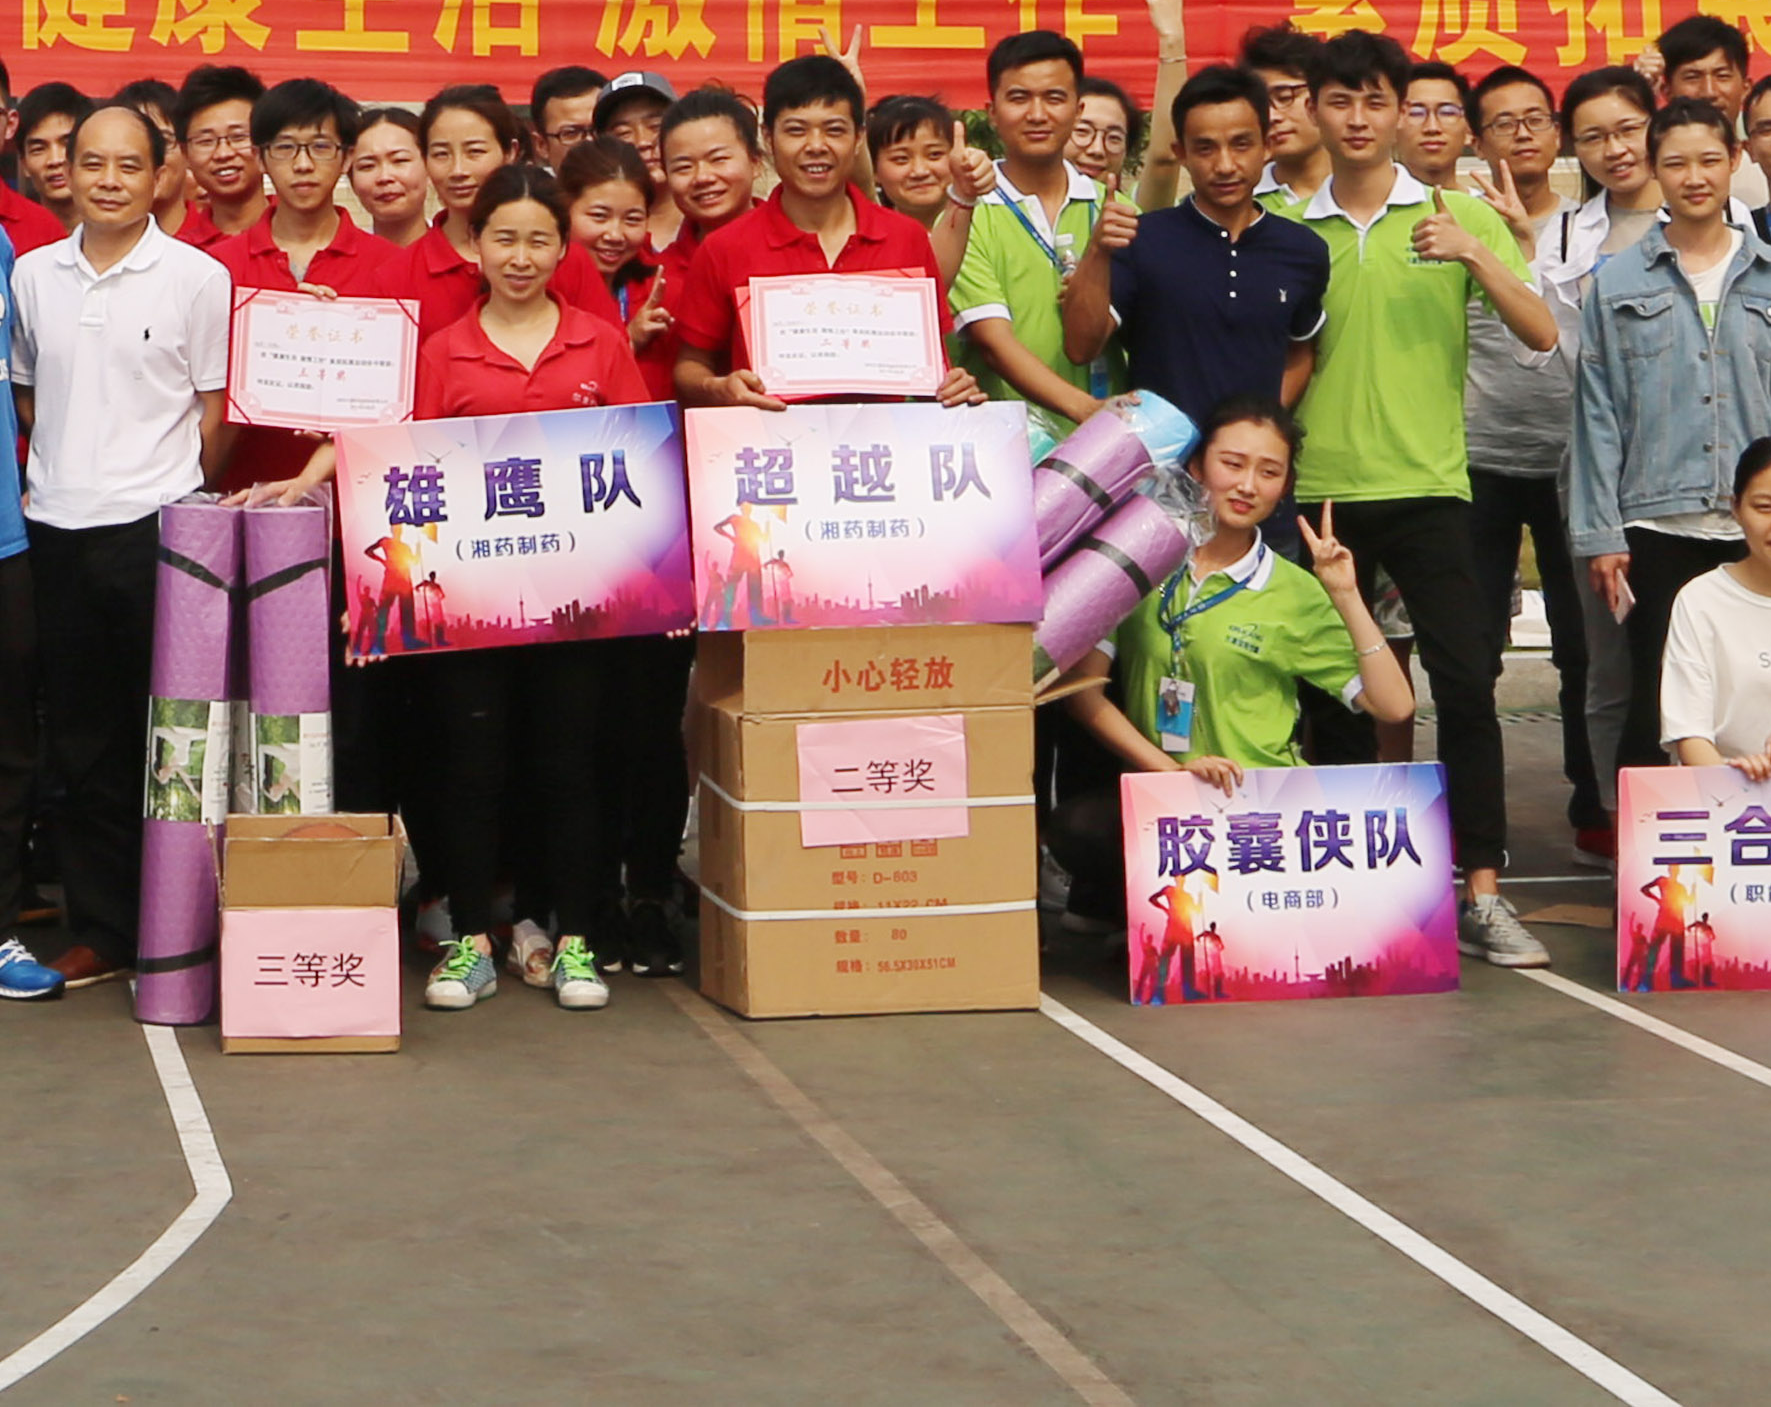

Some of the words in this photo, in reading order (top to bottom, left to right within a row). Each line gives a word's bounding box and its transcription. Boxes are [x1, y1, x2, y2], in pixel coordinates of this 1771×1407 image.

[383, 449, 643, 527] 雄鹰队
[734, 442, 992, 506] 超越队
[823, 656, 955, 693] 小心轻放
[832, 759, 936, 793] 二等奖
[1157, 807, 1422, 877] 胶囊侠队
[1247, 888, 1339, 911] （电商部）
[891, 928, 907, 940] 80
[254, 952, 366, 987] 三等奖
